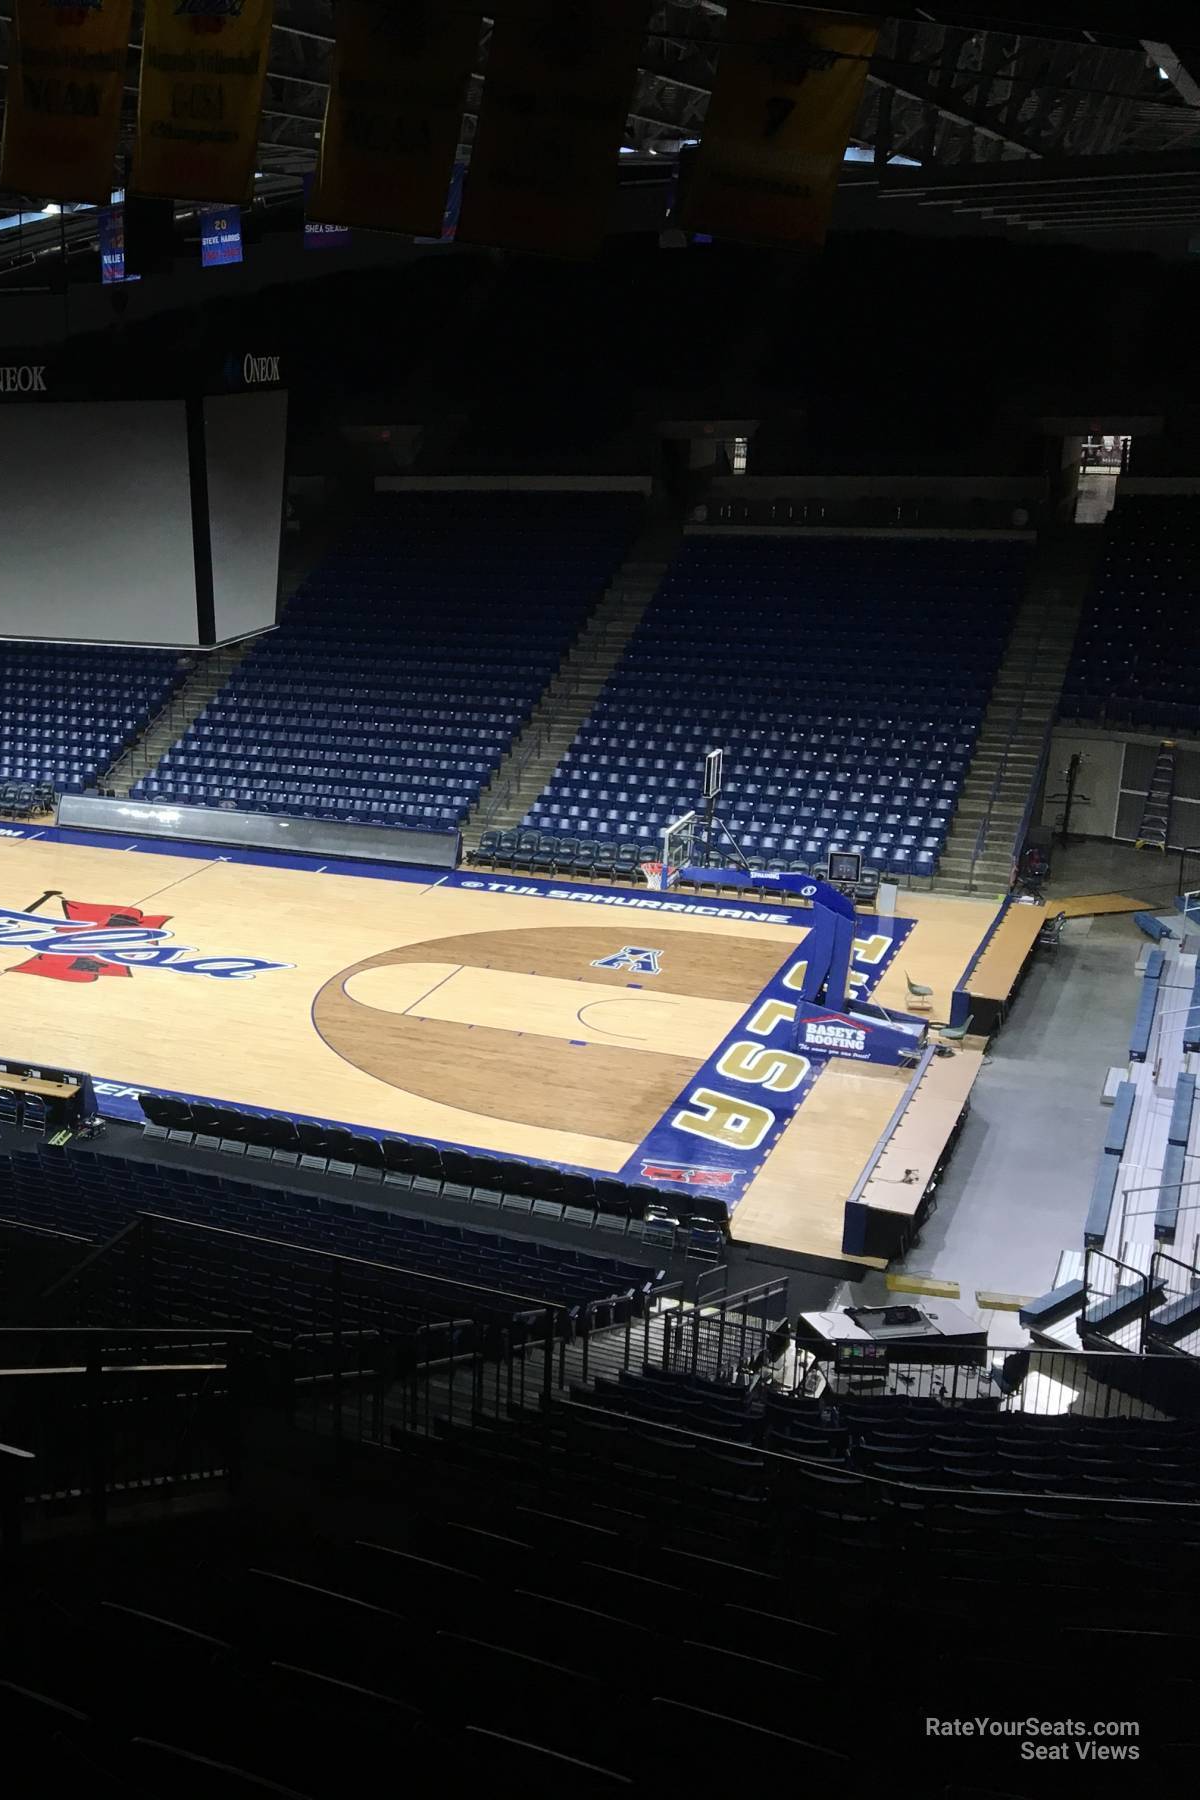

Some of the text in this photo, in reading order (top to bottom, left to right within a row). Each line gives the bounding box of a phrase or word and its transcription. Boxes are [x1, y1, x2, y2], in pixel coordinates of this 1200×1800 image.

[244, 352, 280, 384] ONEOK
[806, 1022, 866, 1041] BASEY'S
[805, 1032, 865, 1051] ROOFING
